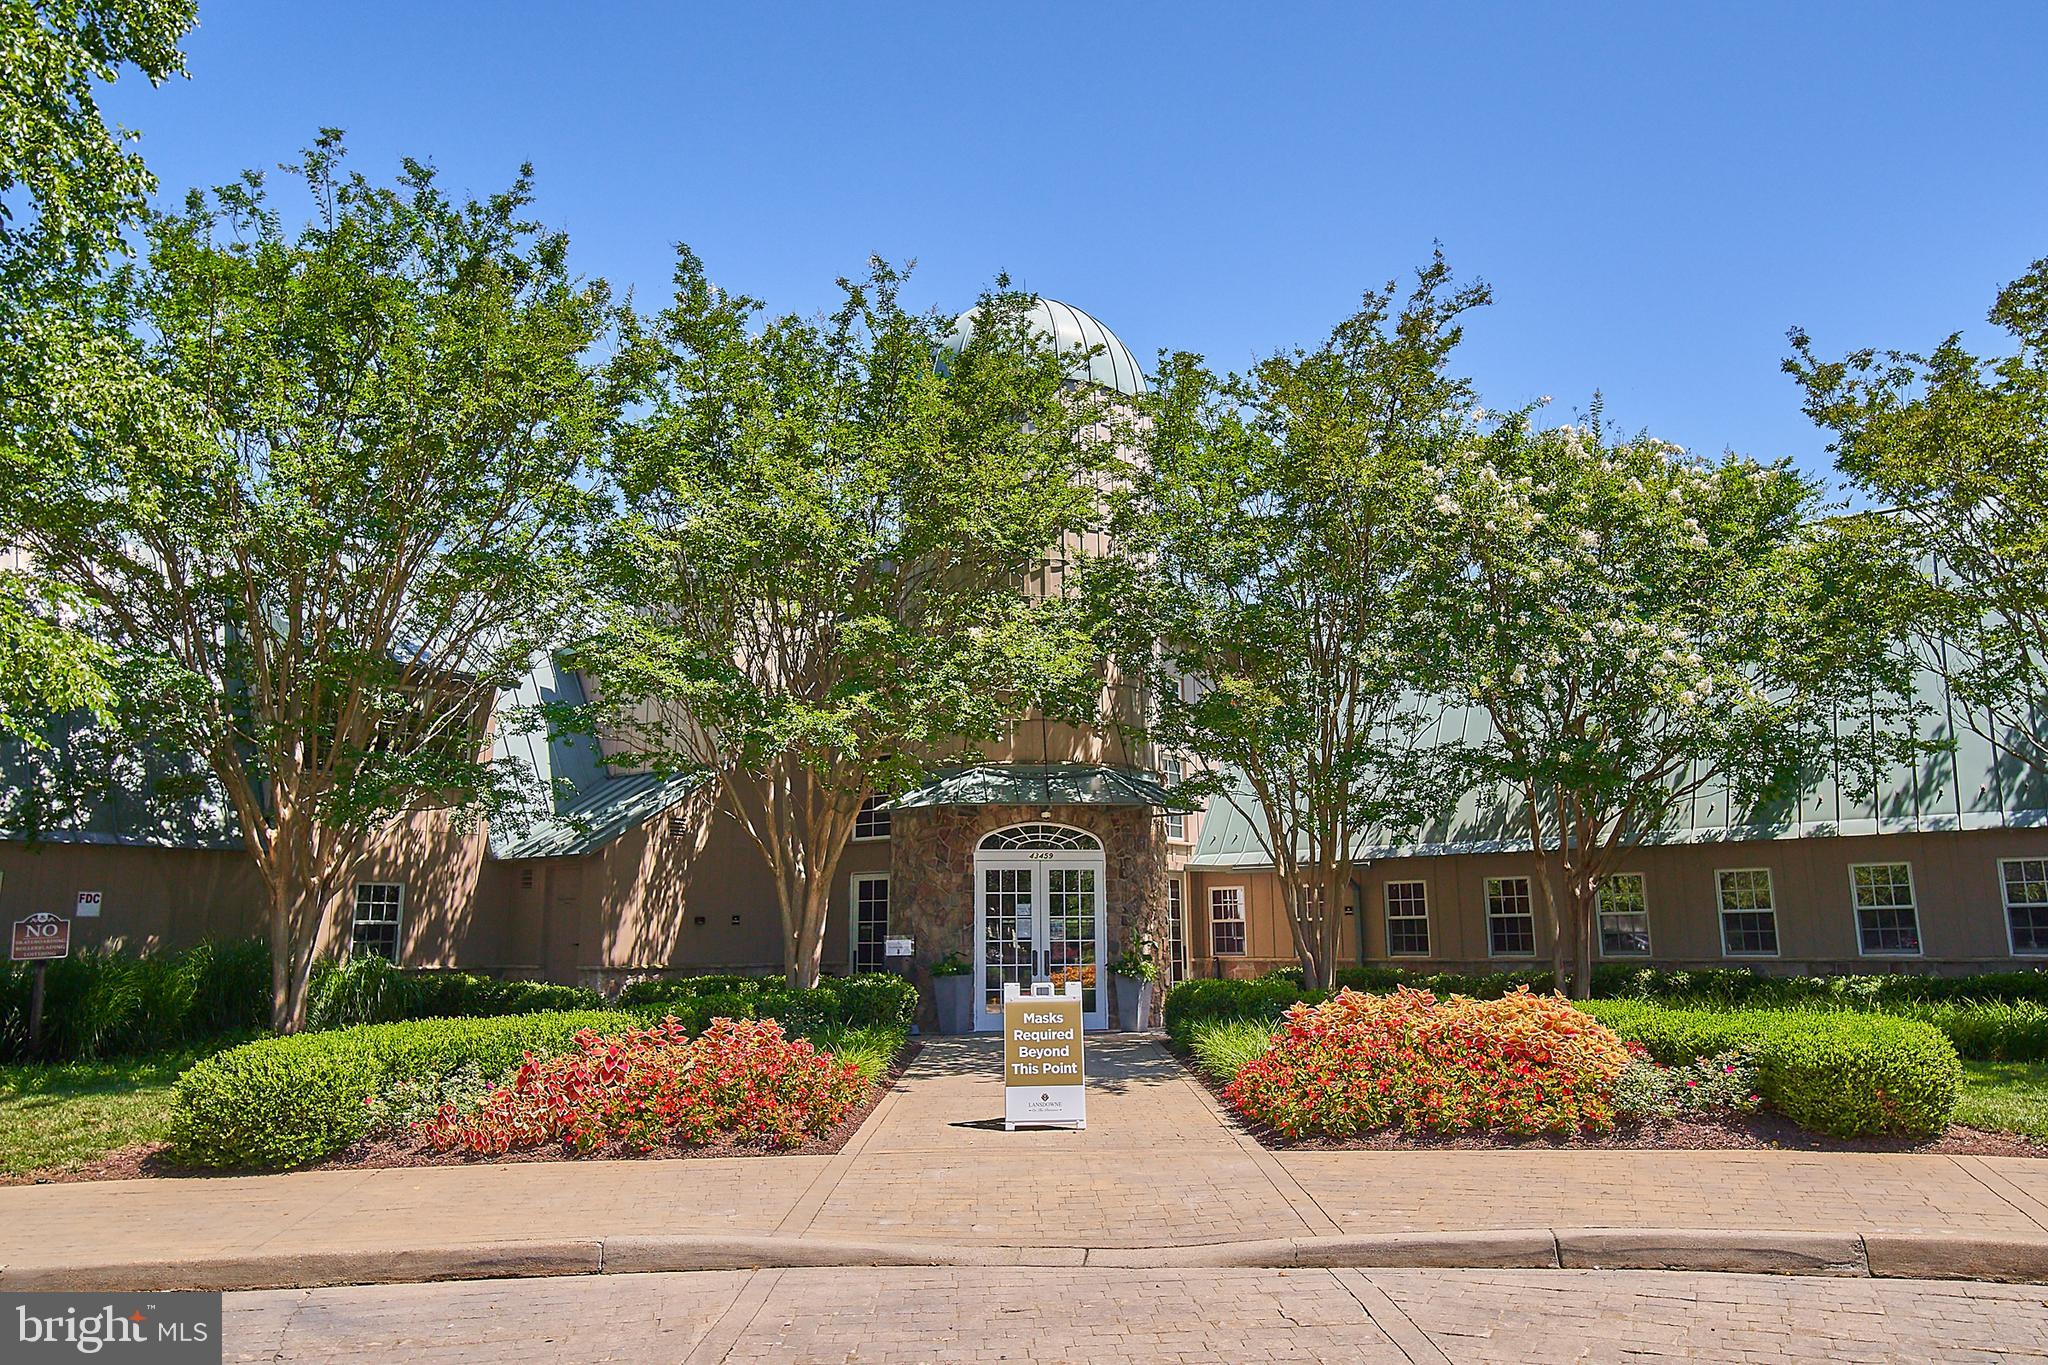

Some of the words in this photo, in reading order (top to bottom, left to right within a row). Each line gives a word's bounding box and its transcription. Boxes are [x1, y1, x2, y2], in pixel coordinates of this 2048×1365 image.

[79, 893, 100, 904] FDC
[26, 924, 58, 937] NO
[1023, 1012, 1064, 1024] Masks
[1013, 1028, 1074, 1042] Required
[1019, 1045, 1070, 1059] Beyond
[1011, 1062, 1039, 1075] This
[1042, 1062, 1078, 1074] Point
